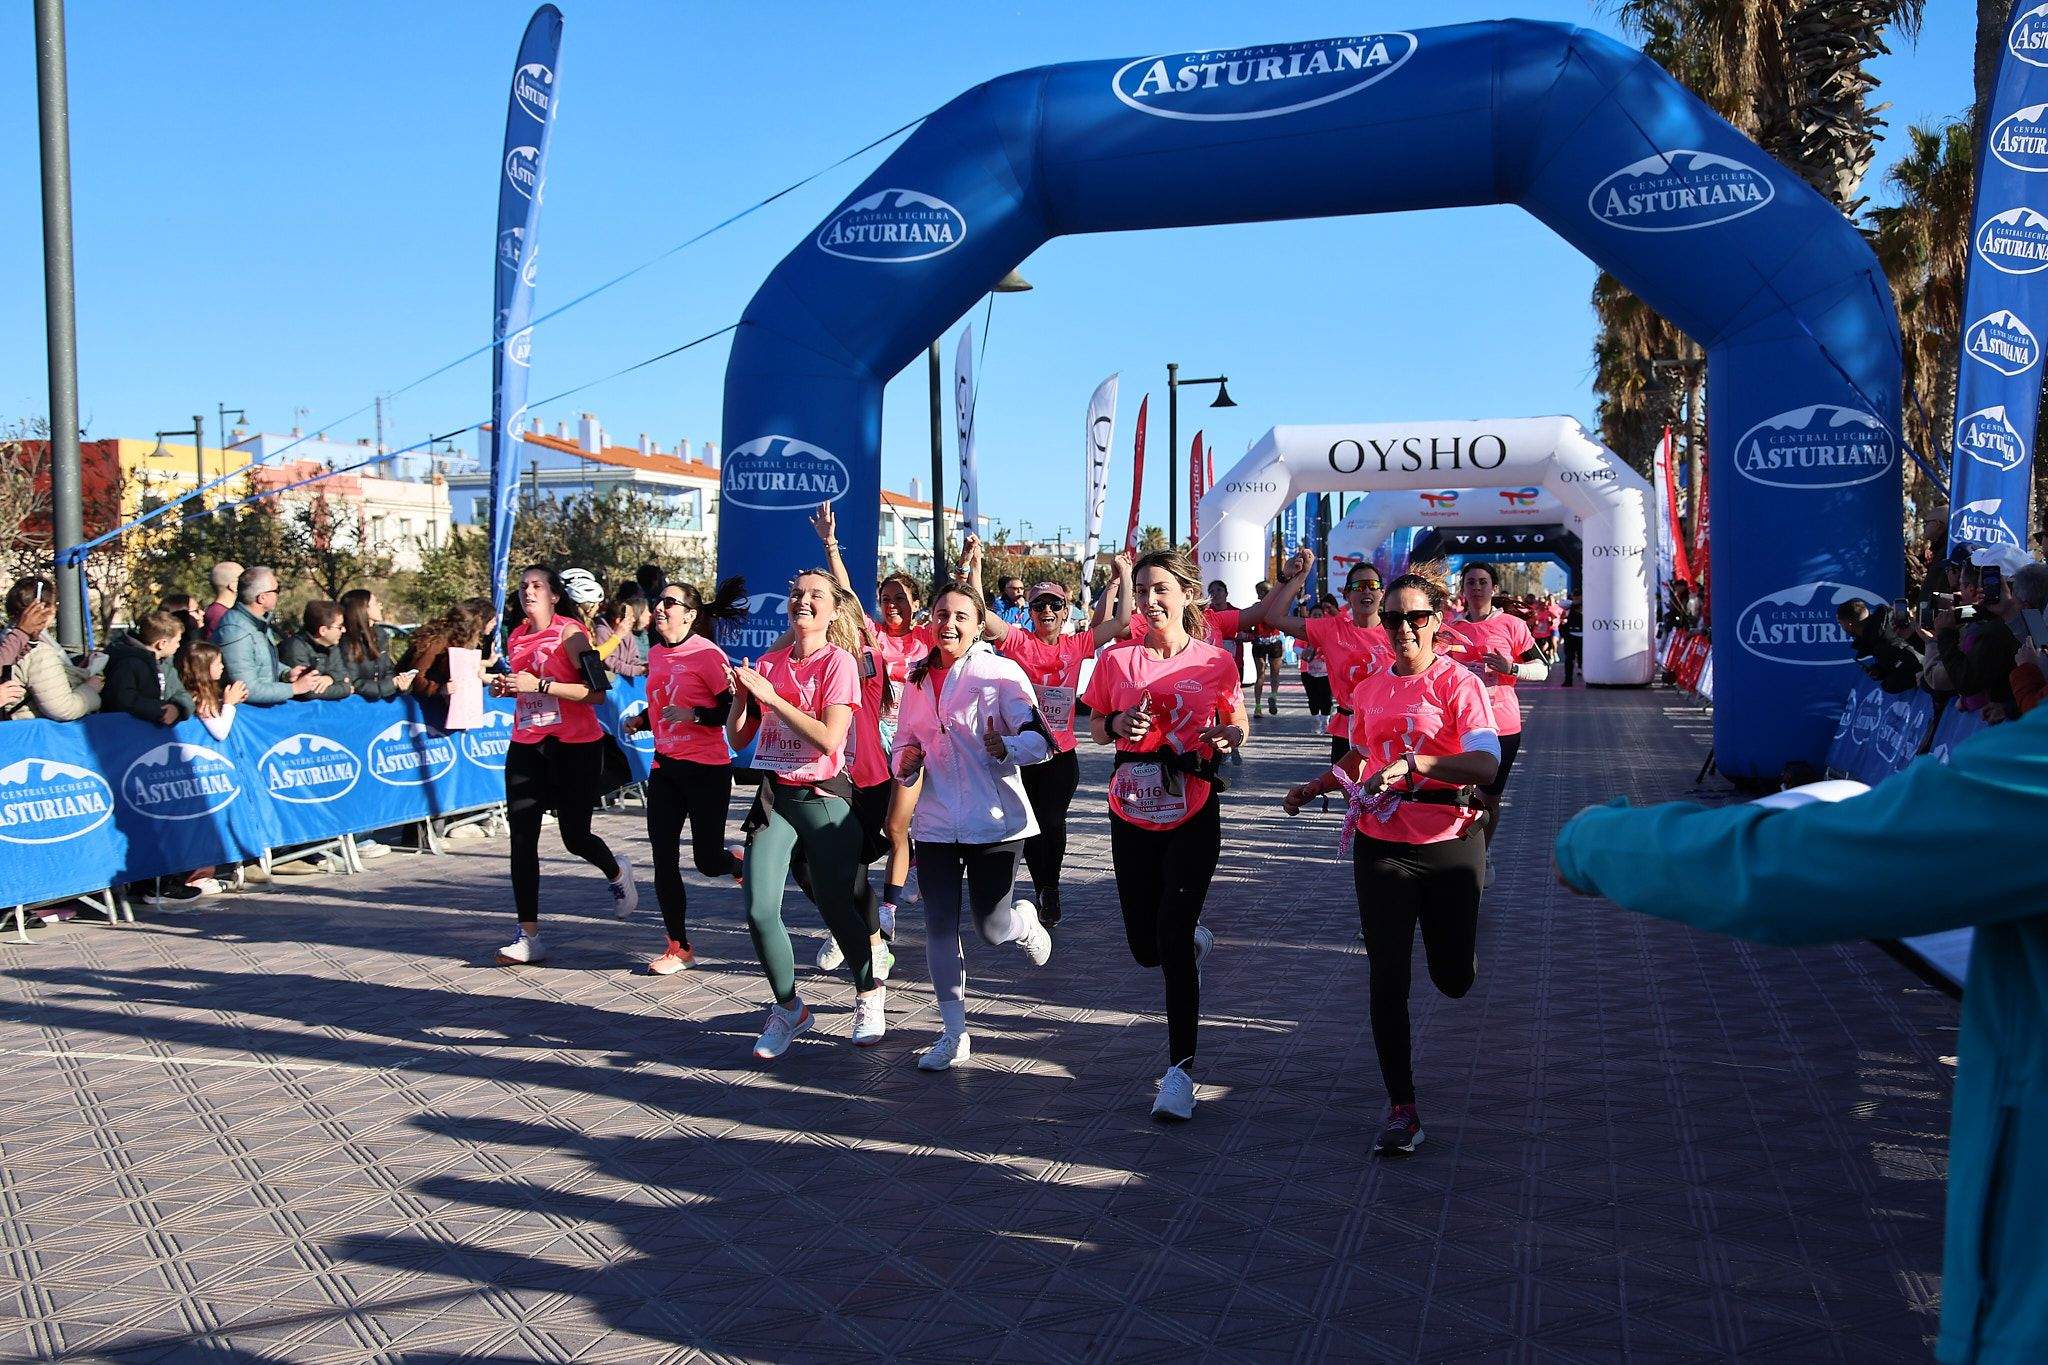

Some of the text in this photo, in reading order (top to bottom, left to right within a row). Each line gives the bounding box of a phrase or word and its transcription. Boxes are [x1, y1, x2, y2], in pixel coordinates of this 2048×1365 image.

[1132, 42, 1392, 97] ASTURIANA
[1628, 172, 1753, 191] CENTRAL LECHERA
[1603, 182, 1764, 218] ASTURIANA
[849, 211, 949, 223] CENTRAL LECHERA
[824, 220, 954, 246] ASTURIANA
[1769, 434, 1829, 445] CENTRAL
[1327, 433, 1508, 474] OYSHO
[1744, 439, 1888, 471] ASTURIANA
[738, 461, 835, 471] CENTRAL LECHERA
[726, 463, 840, 493] ASTURIANA
[1560, 468, 1617, 484] OYSHO
[1225, 480, 1277, 493] OYSHO
[1455, 534, 1545, 545] VOLVO
[1202, 551, 1250, 563] OYSHO
[1592, 545, 1644, 558] OYSHO
[1771, 611, 1831, 620] CENTRAL
[1592, 618, 1644, 632] OYSHO
[1747, 613, 1854, 644] ASTURI
[1043, 706, 1061, 715] 016
[780, 739, 802, 750] 016
[269, 762, 355, 791] ASTURIANA
[48, 781, 97, 794] LECHERA
[134, 774, 234, 806] ASTURIANA
[1136, 787, 1162, 799] 016
